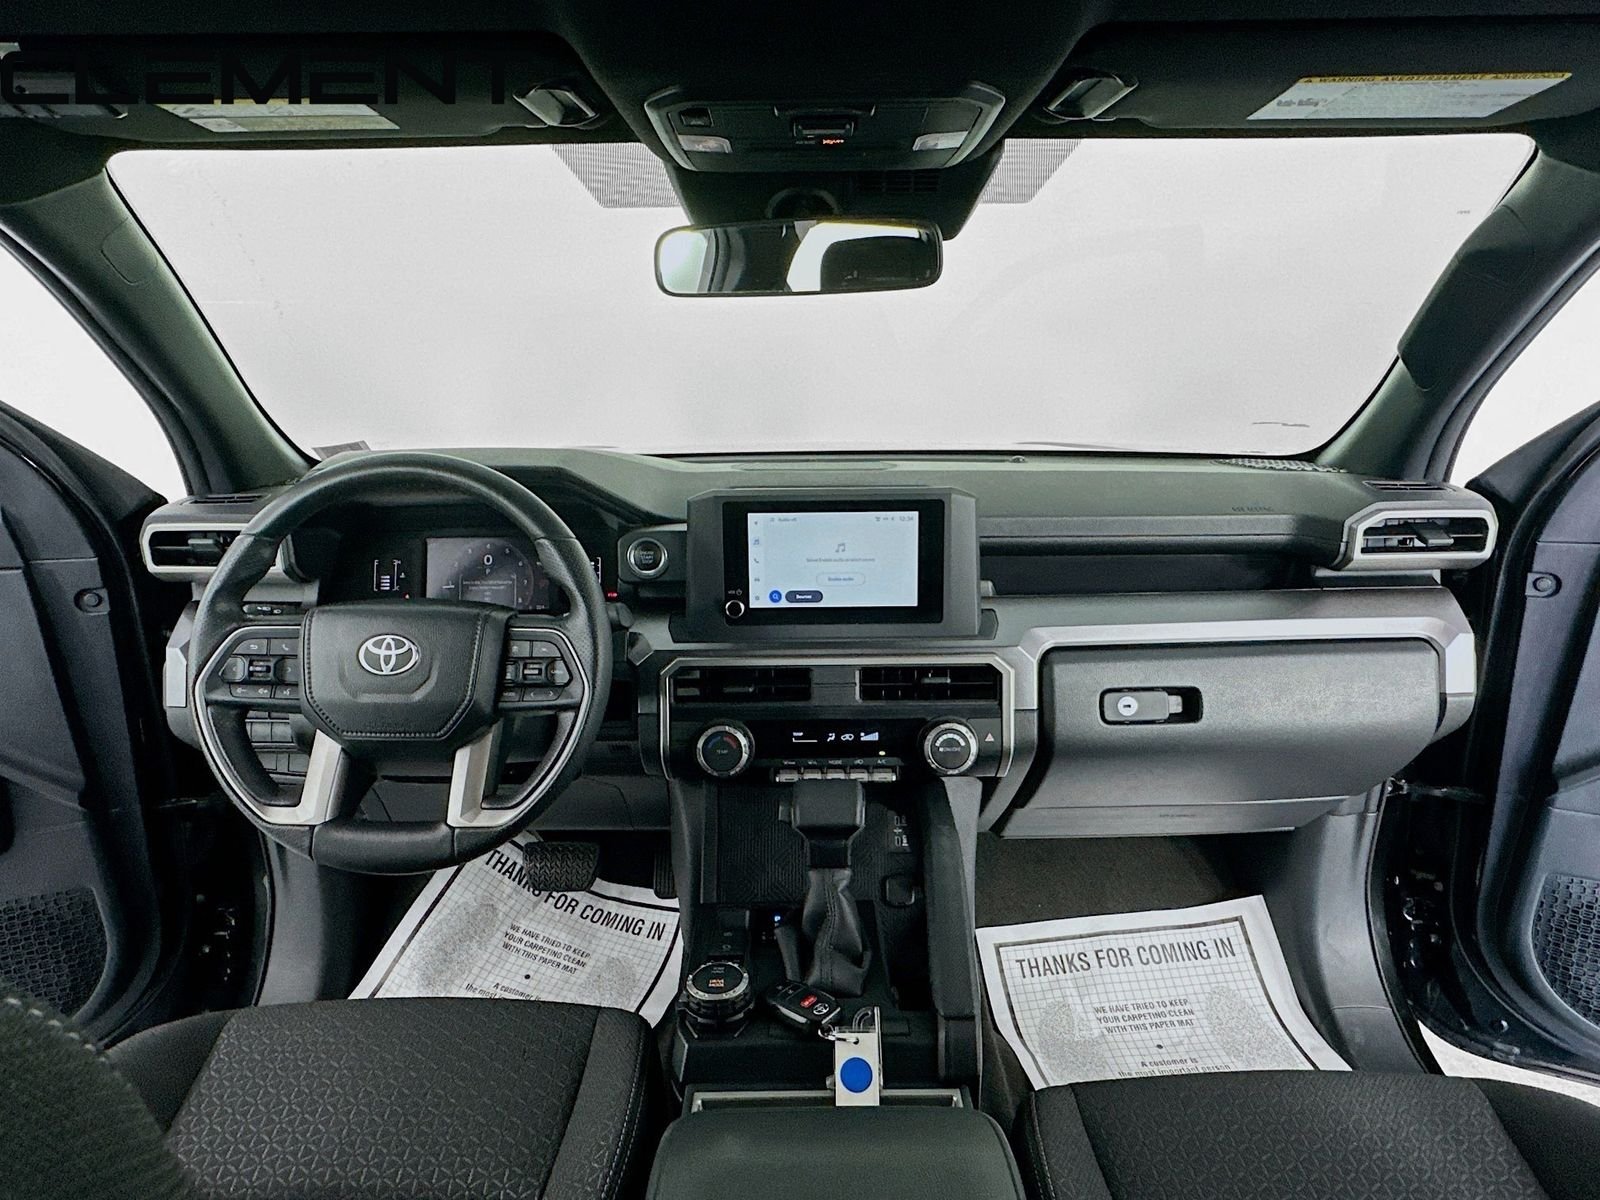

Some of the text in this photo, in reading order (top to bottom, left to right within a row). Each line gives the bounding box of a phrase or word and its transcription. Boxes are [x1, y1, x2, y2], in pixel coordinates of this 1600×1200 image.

[486, 850, 667, 941] THAN FOR COMING IN
[504, 931, 586, 968] YOUR CARPETING CLEAN
[510, 923, 591, 959] WE HAVE TRIED TO KEEP
[502, 941, 577, 975] WITH THIS PAPER MAT
[1015, 937, 1236, 979] THANKS FOR COMING IN
[493, 982, 500, 990] A
[1094, 998, 1189, 1014] WE HAVE TRIED TO KEEP
[1096, 1008, 1195, 1024] YOUR CARPETING CLEAN
[1105, 1018, 1195, 1034] WITH THIS PAPER MAT
[1148, 1058, 1189, 1067] customer
